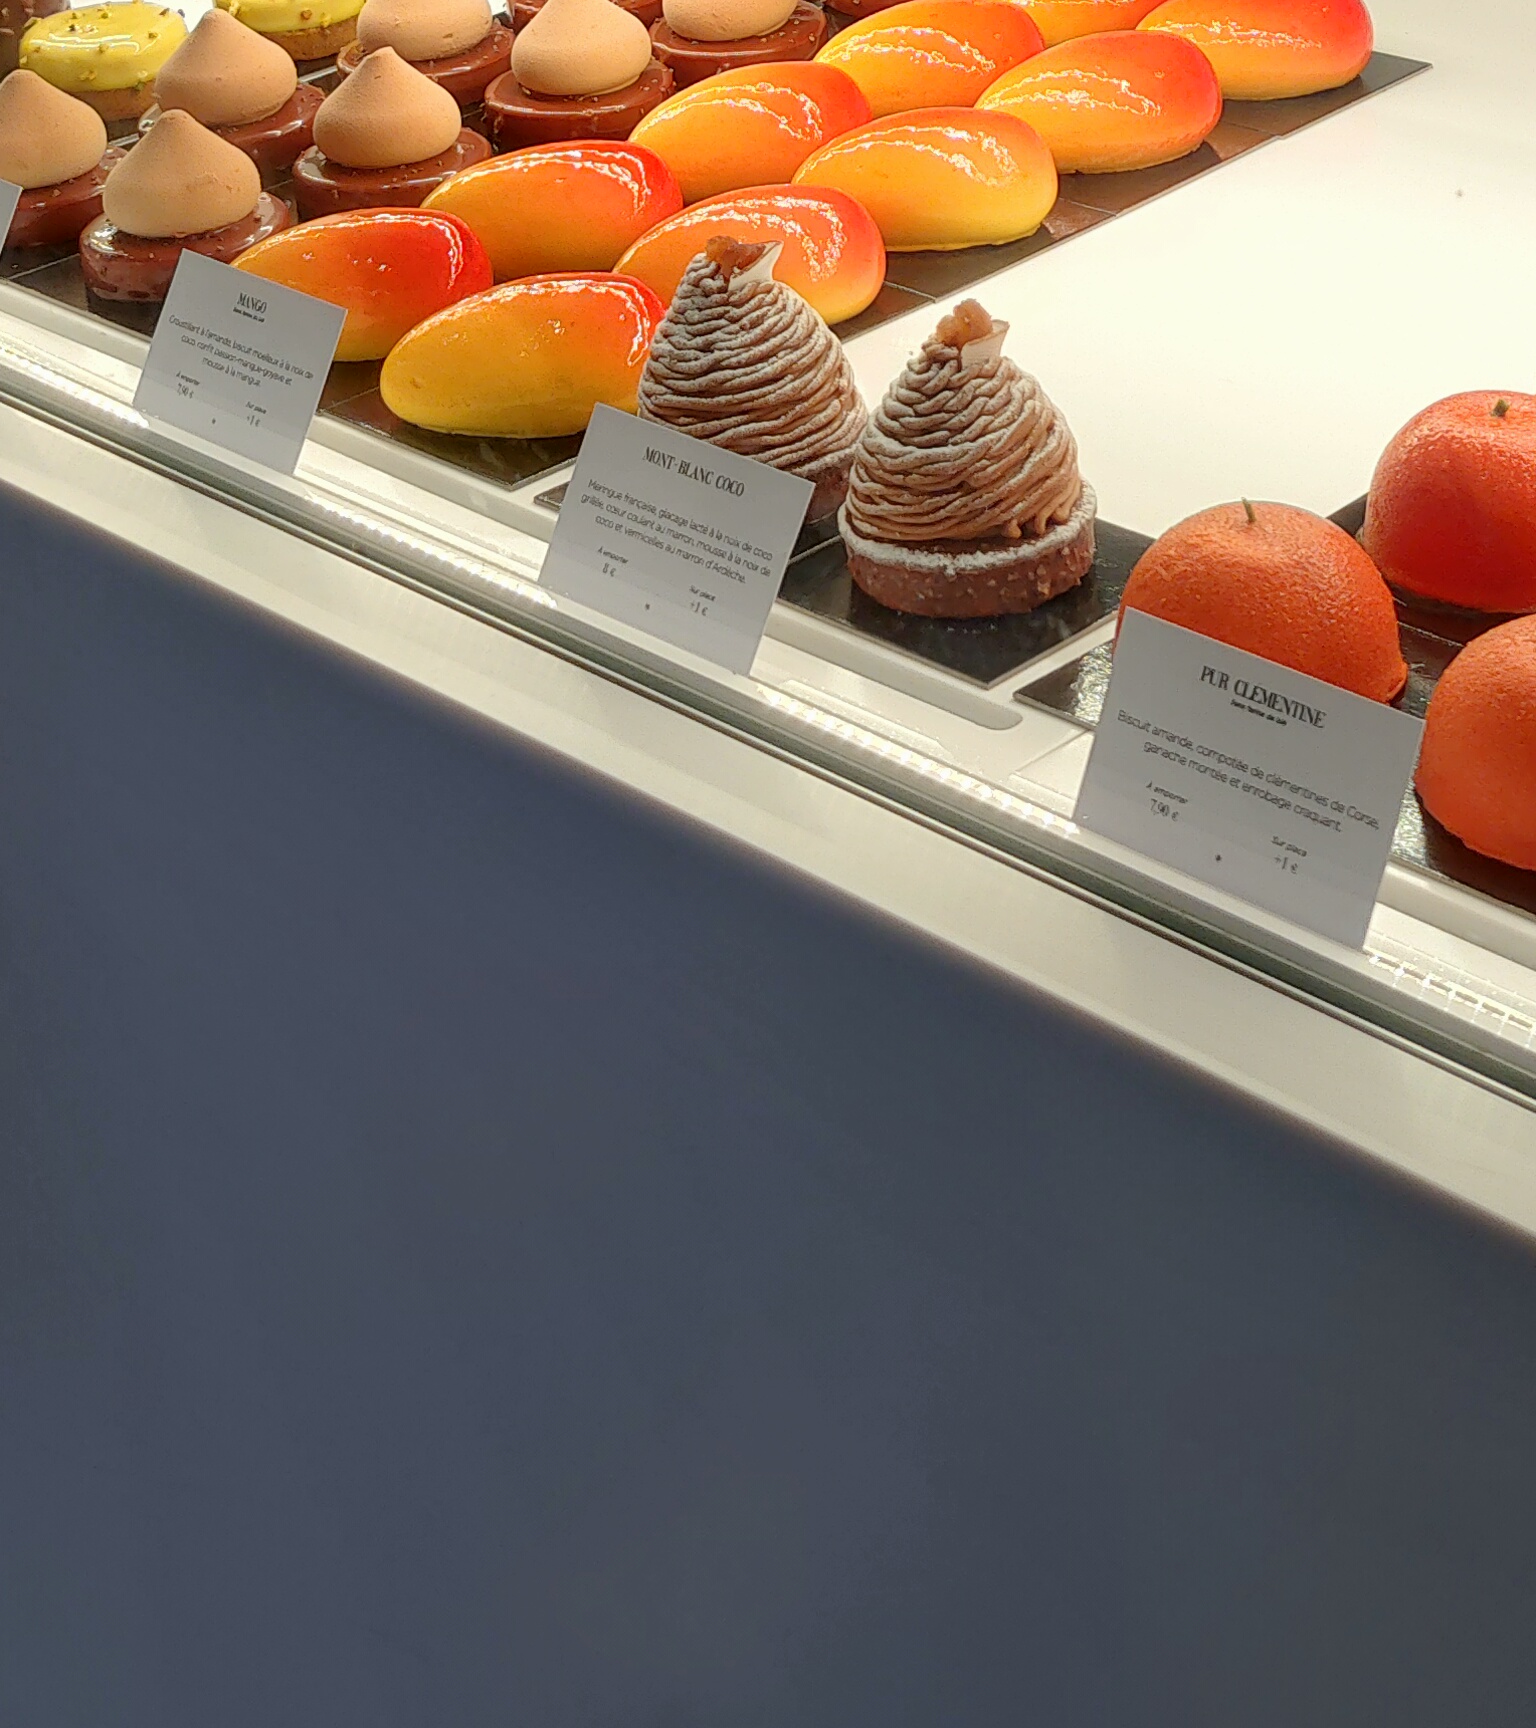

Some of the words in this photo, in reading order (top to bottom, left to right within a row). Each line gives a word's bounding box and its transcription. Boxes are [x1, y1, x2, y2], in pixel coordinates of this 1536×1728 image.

[236, 291, 267, 314] MANGO
[645, 446, 714, 485] MONT-BLANC
[714, 474, 745, 497] COCO
[586, 478, 623, 501] Meringue
[688, 518, 709, 535] lacté
[722, 534, 742, 549] noix
[740, 541, 753, 553] de
[751, 546, 773, 561] coco
[594, 514, 615, 529] coco
[623, 526, 664, 550] vermicelles
[663, 542, 676, 554] au
[674, 547, 705, 566] marron
[625, 511, 656, 530] coulant
[653, 522, 666, 534] au
[695, 539, 727, 559] mousse
[759, 565, 771, 577] de
[1199, 664, 1230, 691] PUR
[1116, 708, 1152, 733] Biscuit
[1195, 744, 1249, 773] compotée
[1249, 765, 1265, 780] de
[1264, 772, 1329, 807] clémentines
[1329, 799, 1346, 814] de
[1142, 740, 1187, 766] ganache
[1187, 758, 1228, 783] montée
[1228, 776, 1241, 789] et
[1241, 782, 1292, 810] enrobage
[1284, 842, 1308, 857] place
